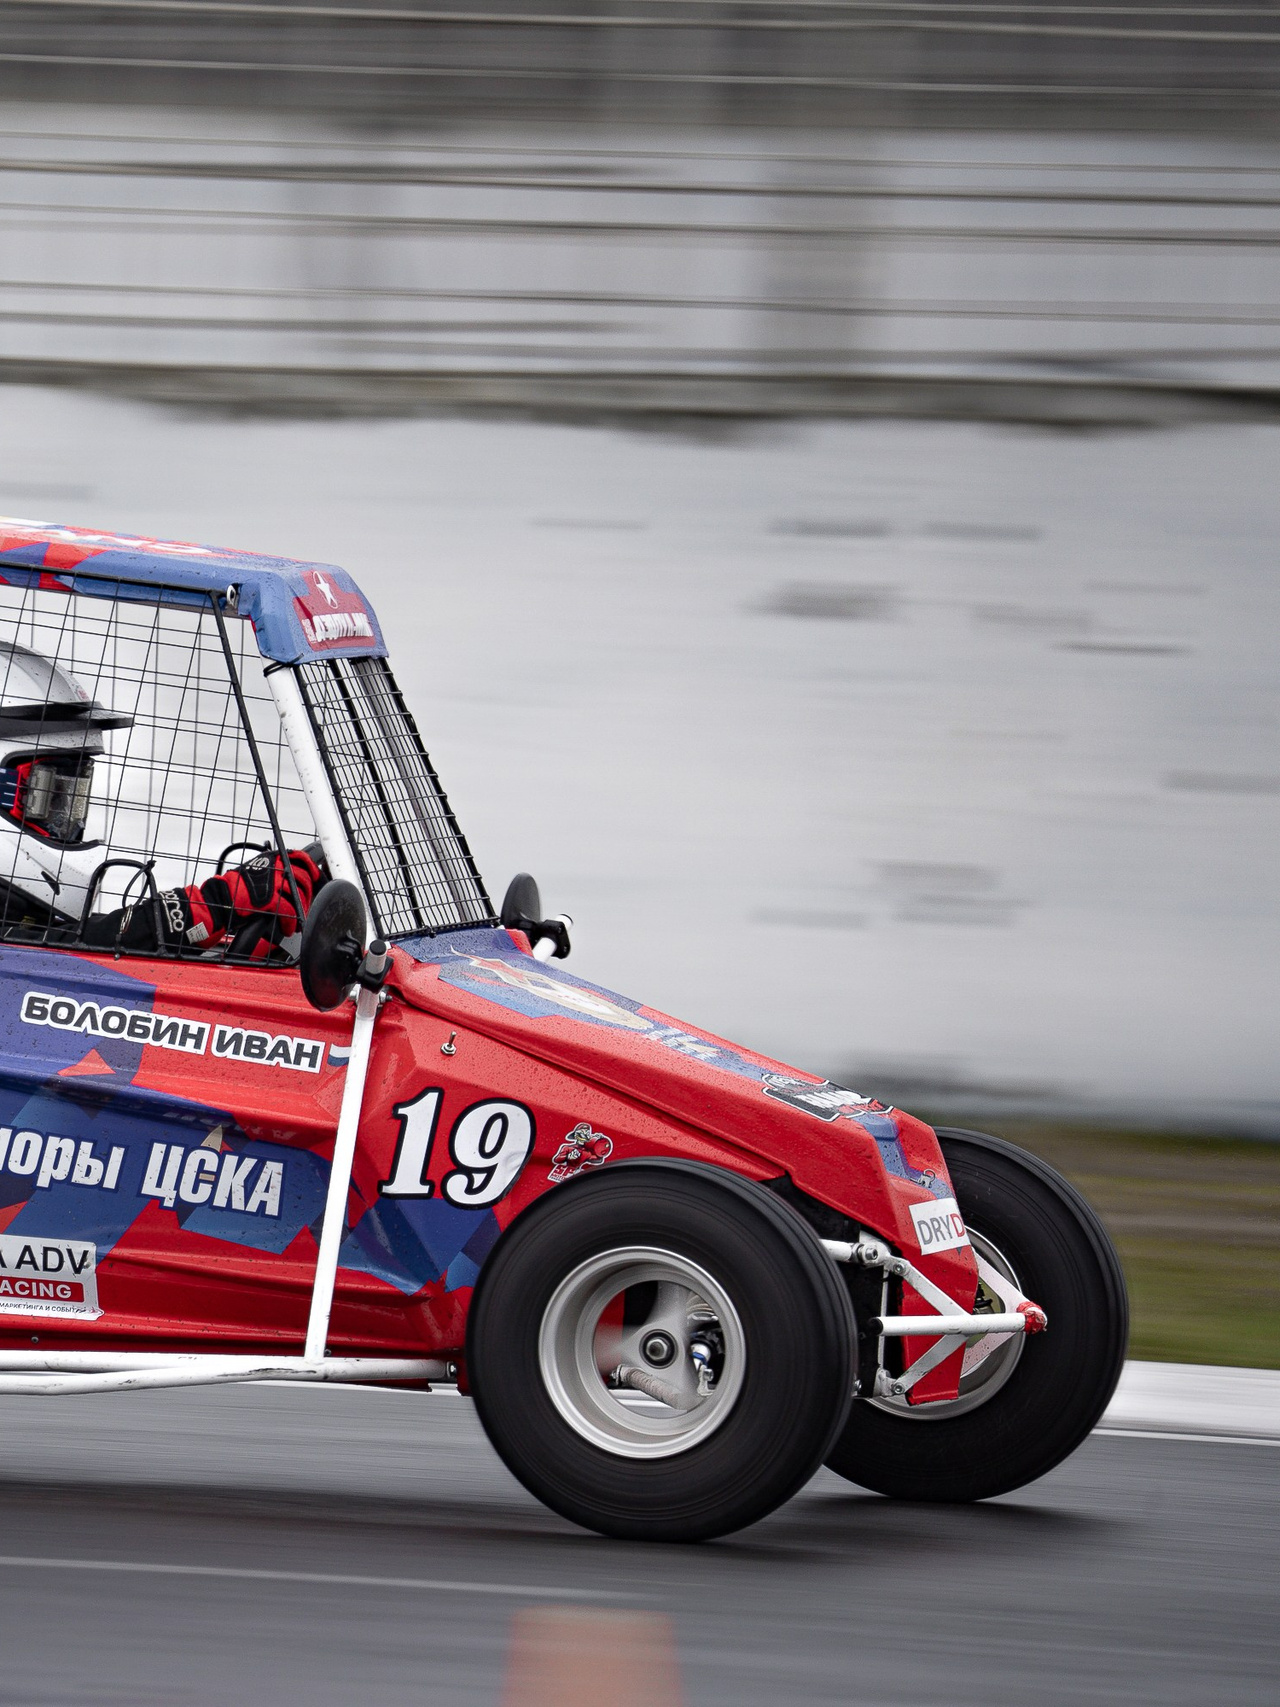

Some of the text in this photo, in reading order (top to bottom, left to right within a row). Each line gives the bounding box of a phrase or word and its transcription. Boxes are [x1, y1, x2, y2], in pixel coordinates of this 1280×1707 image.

[24, 996, 322, 1069] БОЛОБИН ИВАН
[141, 1142, 284, 1217] ЦСКА
[380, 1090, 534, 1208] 19
[15, 1244, 90, 1275] ADV
[916, 1213, 966, 1246] DRYD
